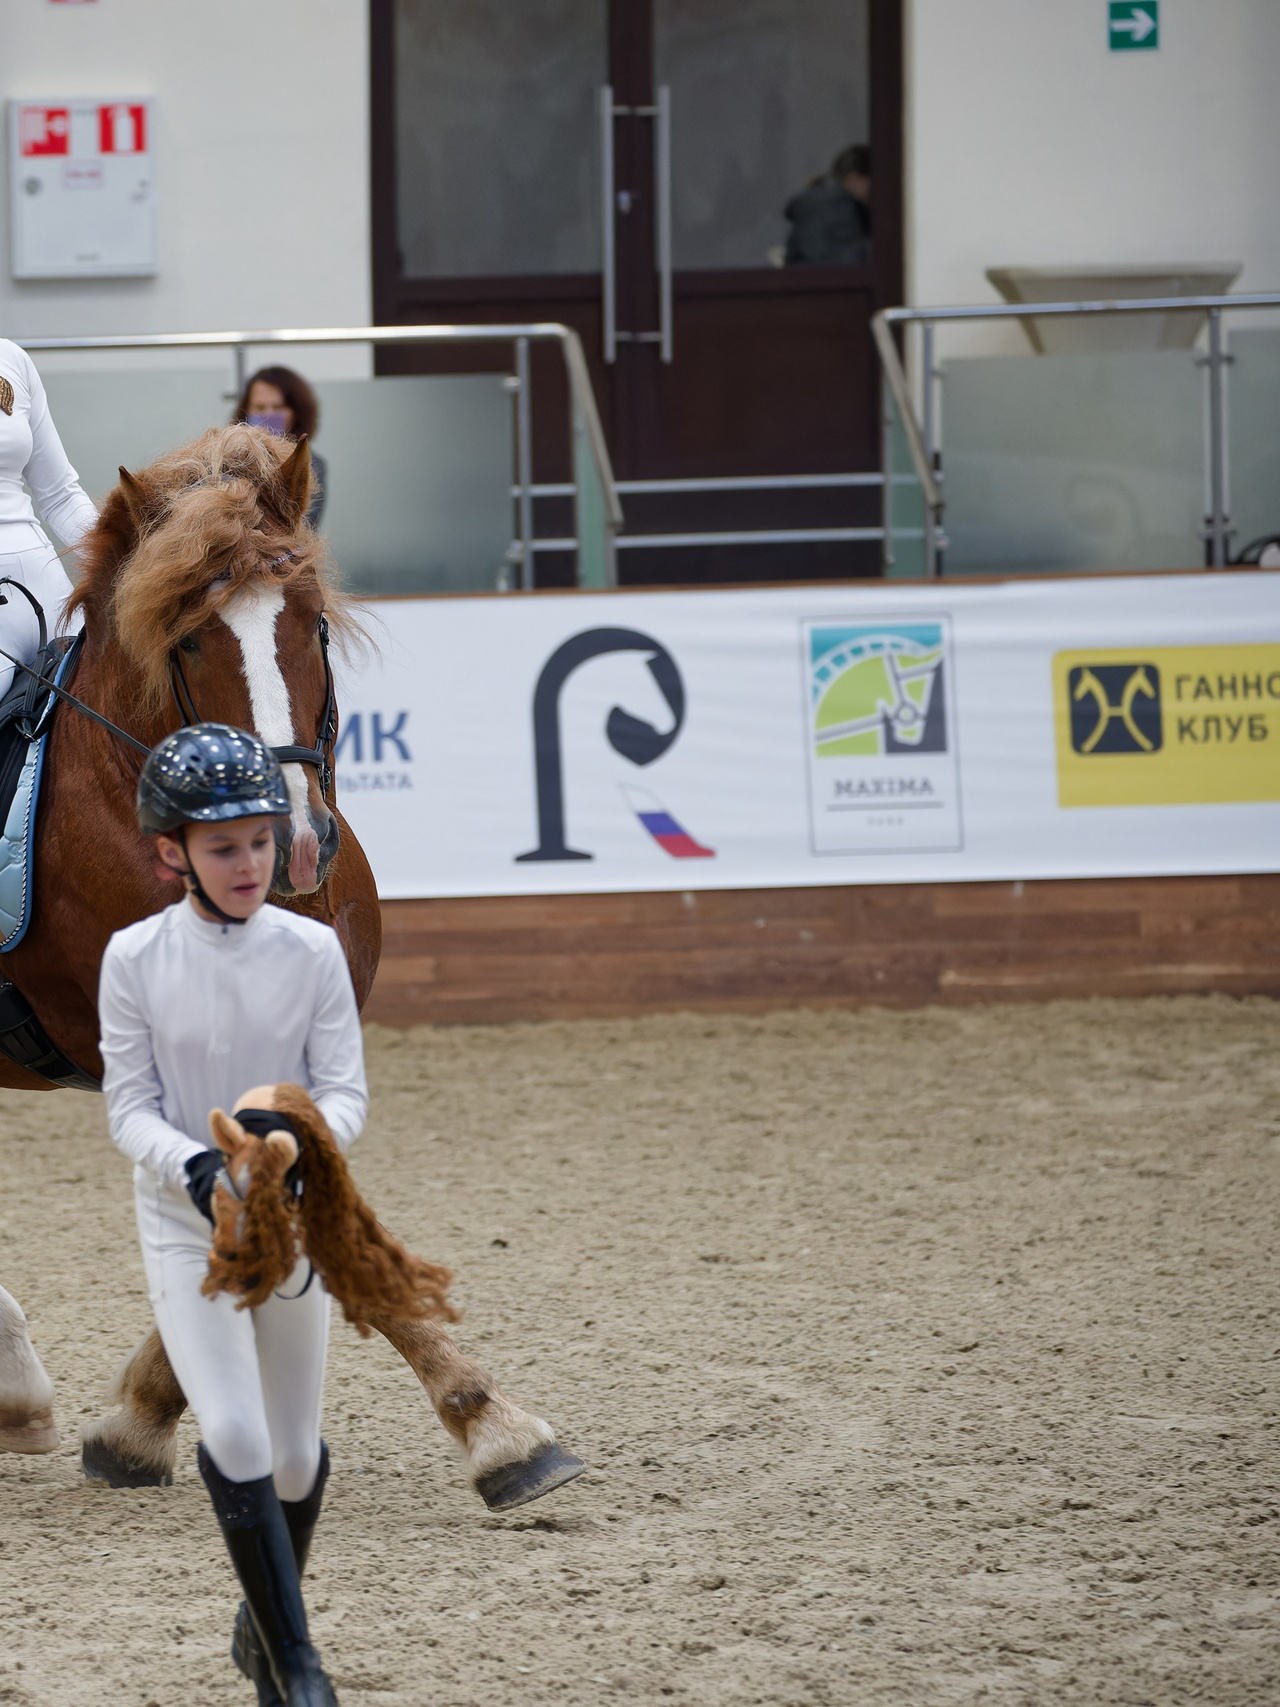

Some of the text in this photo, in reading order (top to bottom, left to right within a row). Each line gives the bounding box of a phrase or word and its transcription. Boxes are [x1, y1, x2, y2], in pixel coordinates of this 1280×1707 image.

[1175, 671, 1280, 701] ГАННО
[335, 710, 414, 763] ИК
[1176, 712, 1269, 744] КЛУБ
[833, 776, 934, 799] MAXIMA
